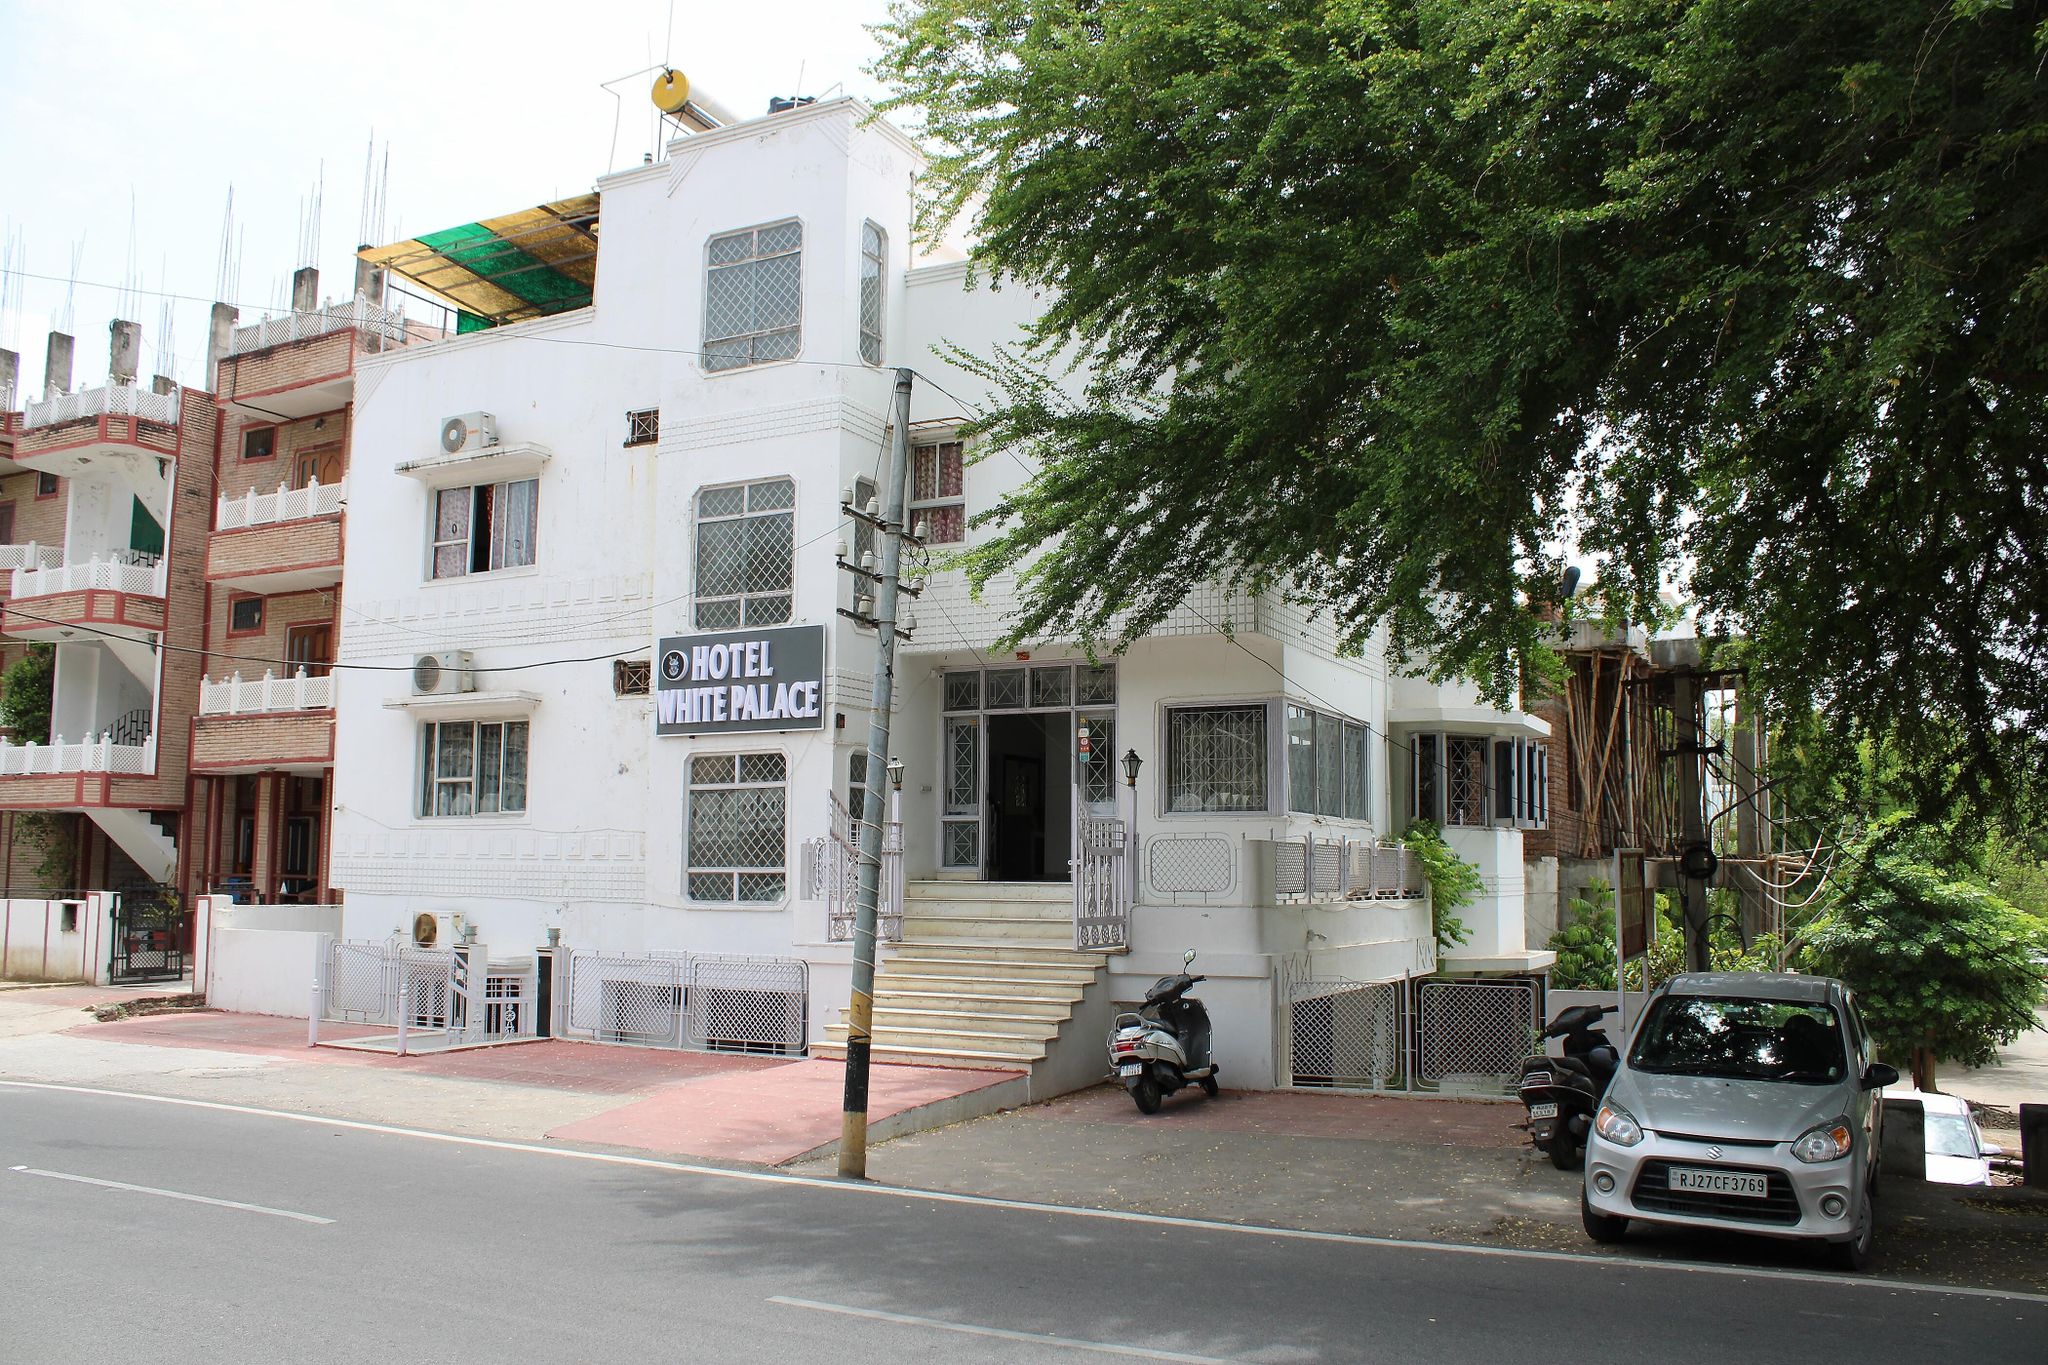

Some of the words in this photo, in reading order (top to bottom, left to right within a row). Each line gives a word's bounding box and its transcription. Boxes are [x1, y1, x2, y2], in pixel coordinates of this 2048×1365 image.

[691, 641, 774, 681] HOTEL
[657, 686, 728, 724] WHITE
[730, 681, 820, 721] PALACE
[1680, 1173, 1764, 1192] RJ27CF3769
